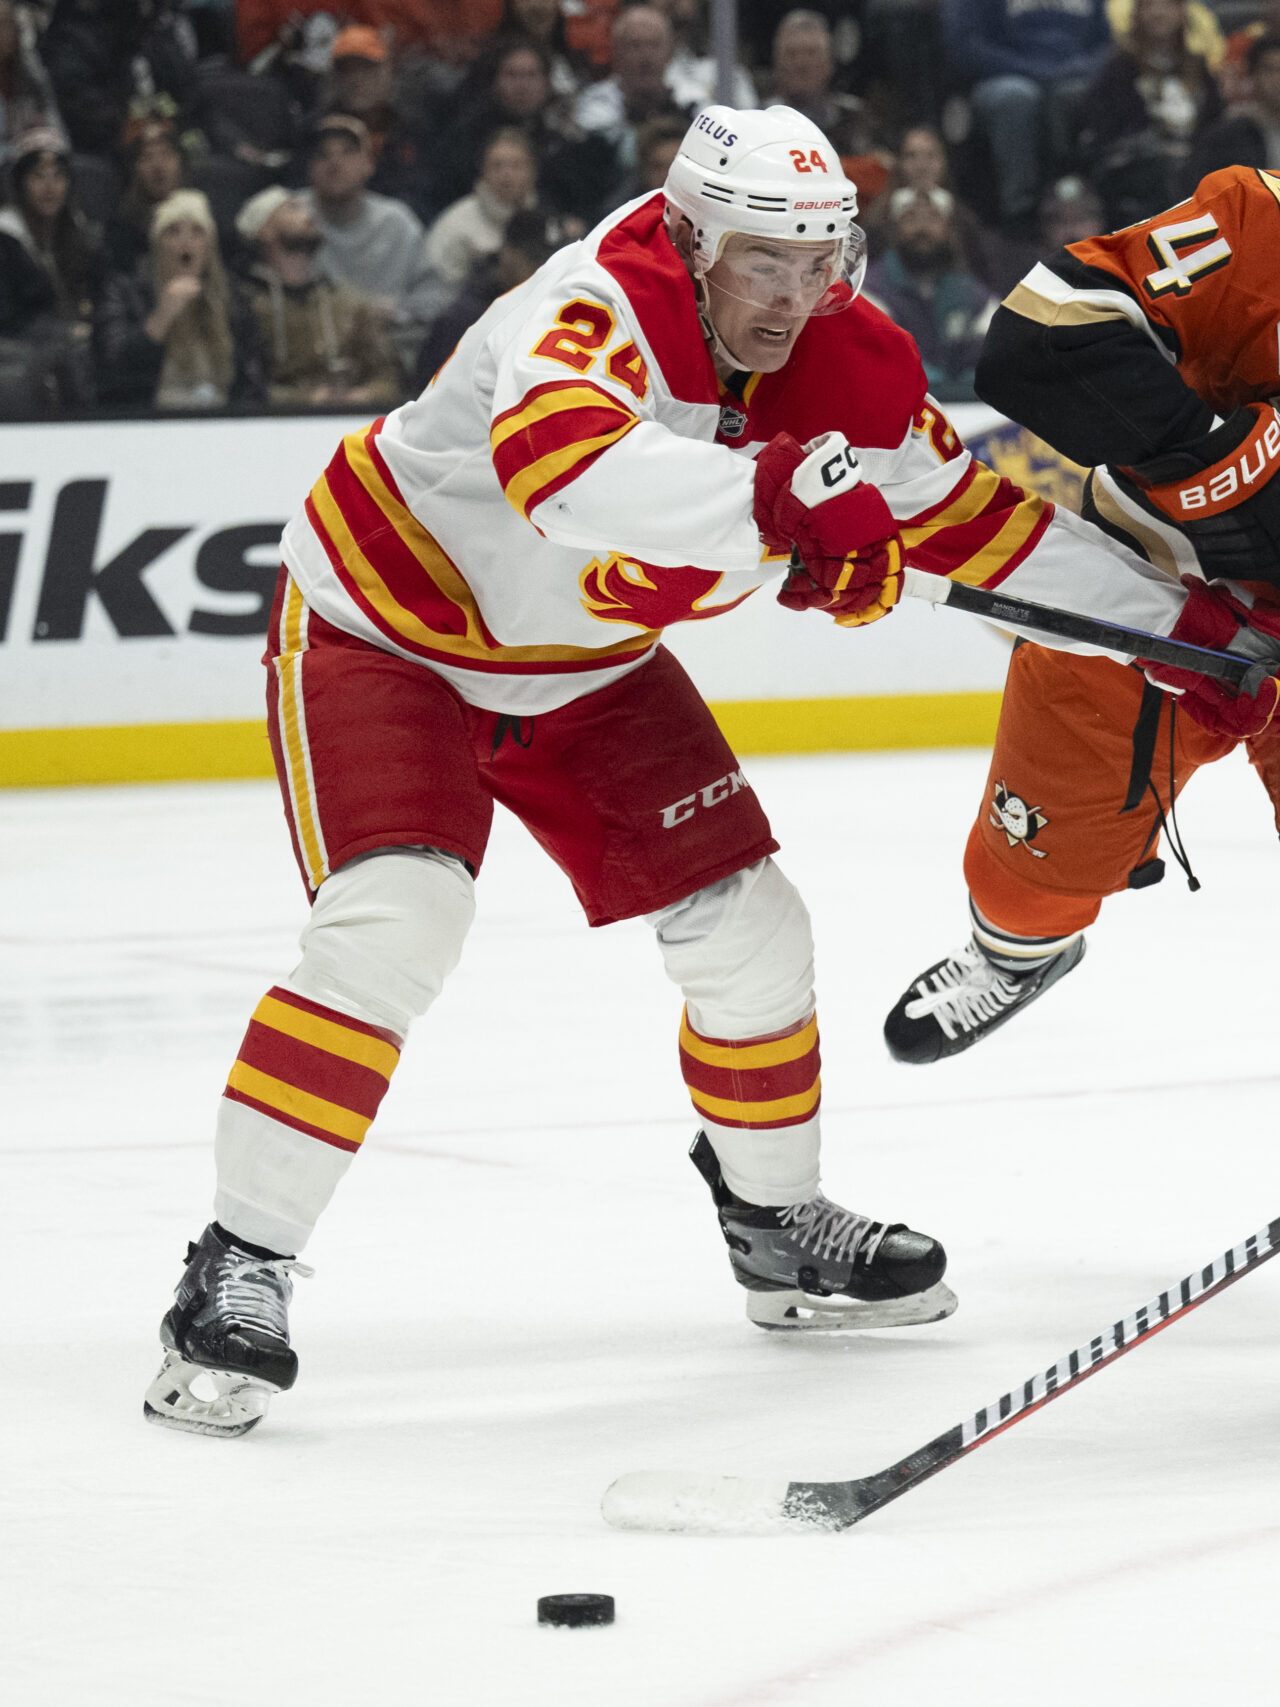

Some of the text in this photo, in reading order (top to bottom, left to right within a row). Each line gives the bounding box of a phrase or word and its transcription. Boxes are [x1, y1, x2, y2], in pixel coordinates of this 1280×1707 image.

[694, 114, 739, 147] TELUS
[789, 150, 828, 173] 24
[793, 201, 842, 210] BAUER
[528, 298, 648, 403] 24
[722, 418, 740, 427] NHL
[657, 767, 750, 829] CCM
[961, 1223, 1273, 1447] WARRIOR
